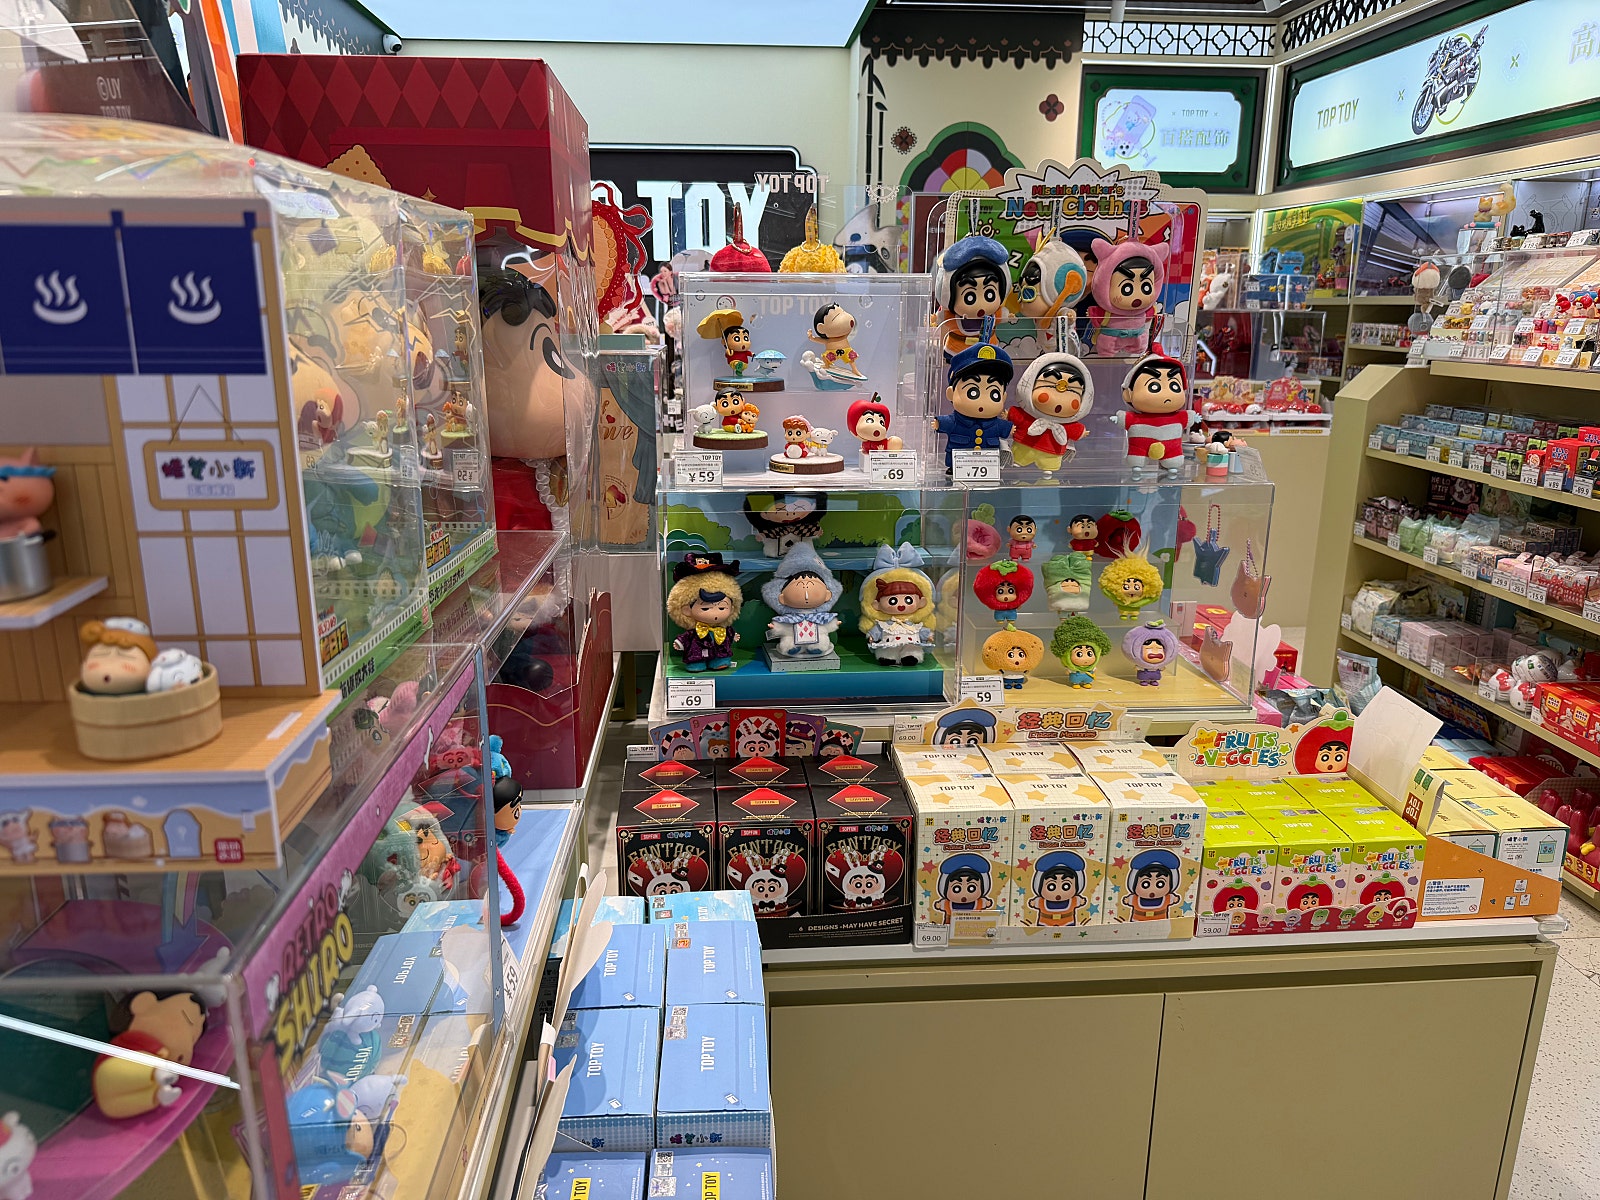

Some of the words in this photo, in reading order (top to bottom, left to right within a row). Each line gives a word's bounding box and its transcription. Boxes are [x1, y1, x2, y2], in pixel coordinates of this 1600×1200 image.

[1569, 20, 1600, 65] 高
[1317, 105, 1336, 130] TOP
[1337, 98, 1360, 123] TOY
[1007, 196, 1053, 218] New
[1018, 711, 1113, 729] 经典回忆
[1214, 732, 1279, 749] FRUITS
[934, 826, 999, 843] 经典回忆
[1030, 824, 1094, 841] 经典回忆
[1127, 823, 1191, 839] 经典回忆
[627, 842, 707, 868] FANTASY
[727, 837, 805, 867] FANTASY
[826, 835, 903, 858] FANTASY
[1228, 857, 1261, 867] FRUITS
[1302, 854, 1336, 865] FRUITS
[1376, 852, 1410, 862] FRUITS
[858, 920, 877, 928] HAVE
[878, 917, 904, 926] SECRET
[605, 949, 619, 963] TOY
[703, 945, 715, 960] TOY
[604, 961, 617, 977] TOP
[703, 959, 716, 975] TOP
[275, 912, 354, 1076] SHIRO
[589, 1041, 605, 1060] TOY
[701, 1035, 716, 1055] TOY
[587, 1058, 603, 1078] TOP
[701, 1054, 714, 1072] TOP
[573, 1180, 588, 1197] TOY
[704, 1174, 717, 1188] TOY
